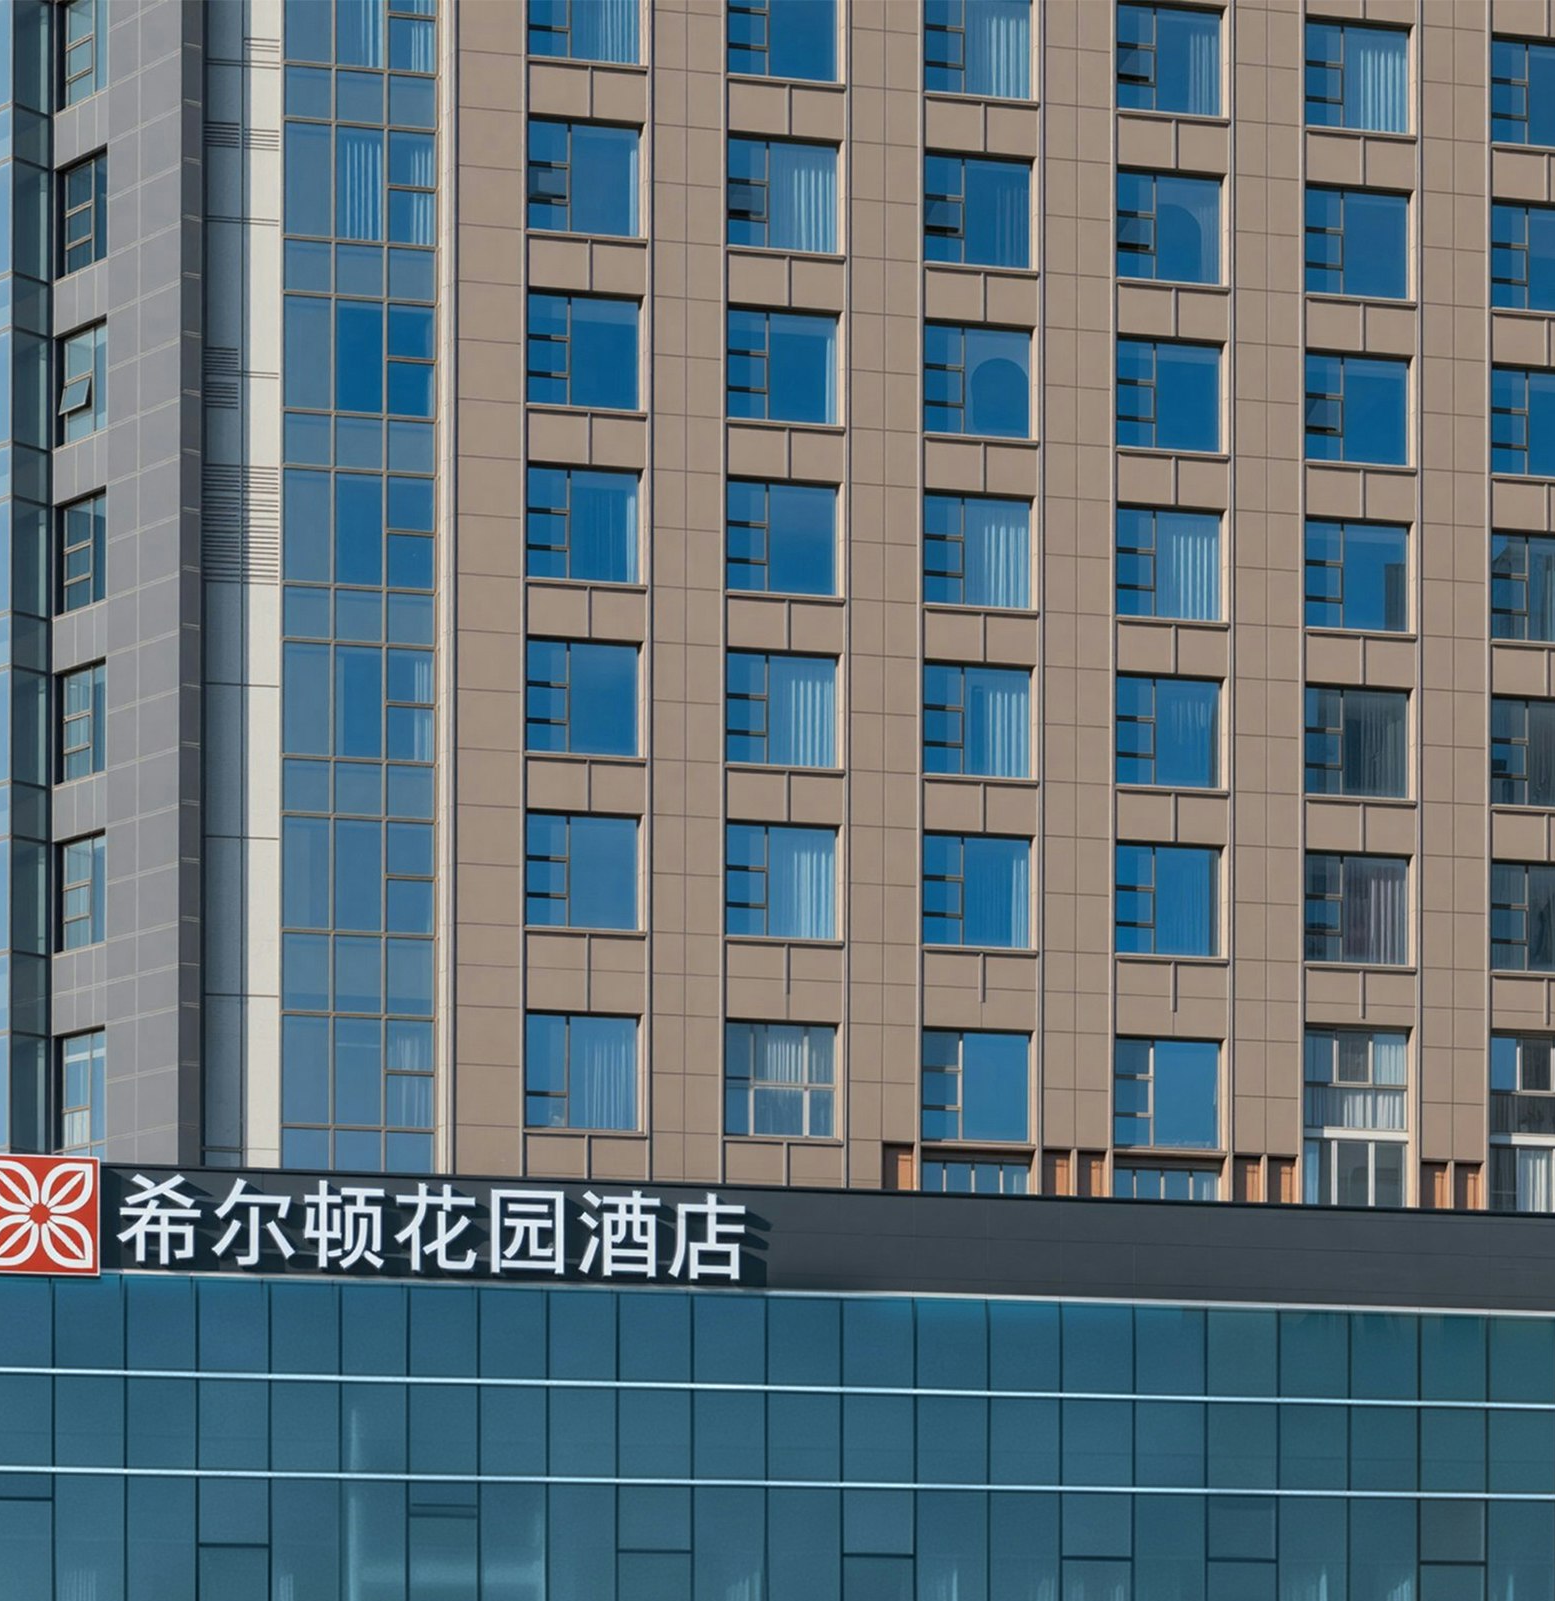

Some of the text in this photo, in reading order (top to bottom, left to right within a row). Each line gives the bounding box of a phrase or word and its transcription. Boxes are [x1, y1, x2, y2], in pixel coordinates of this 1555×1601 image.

[116, 1173, 747, 1280] 希尔顿花园酒店
